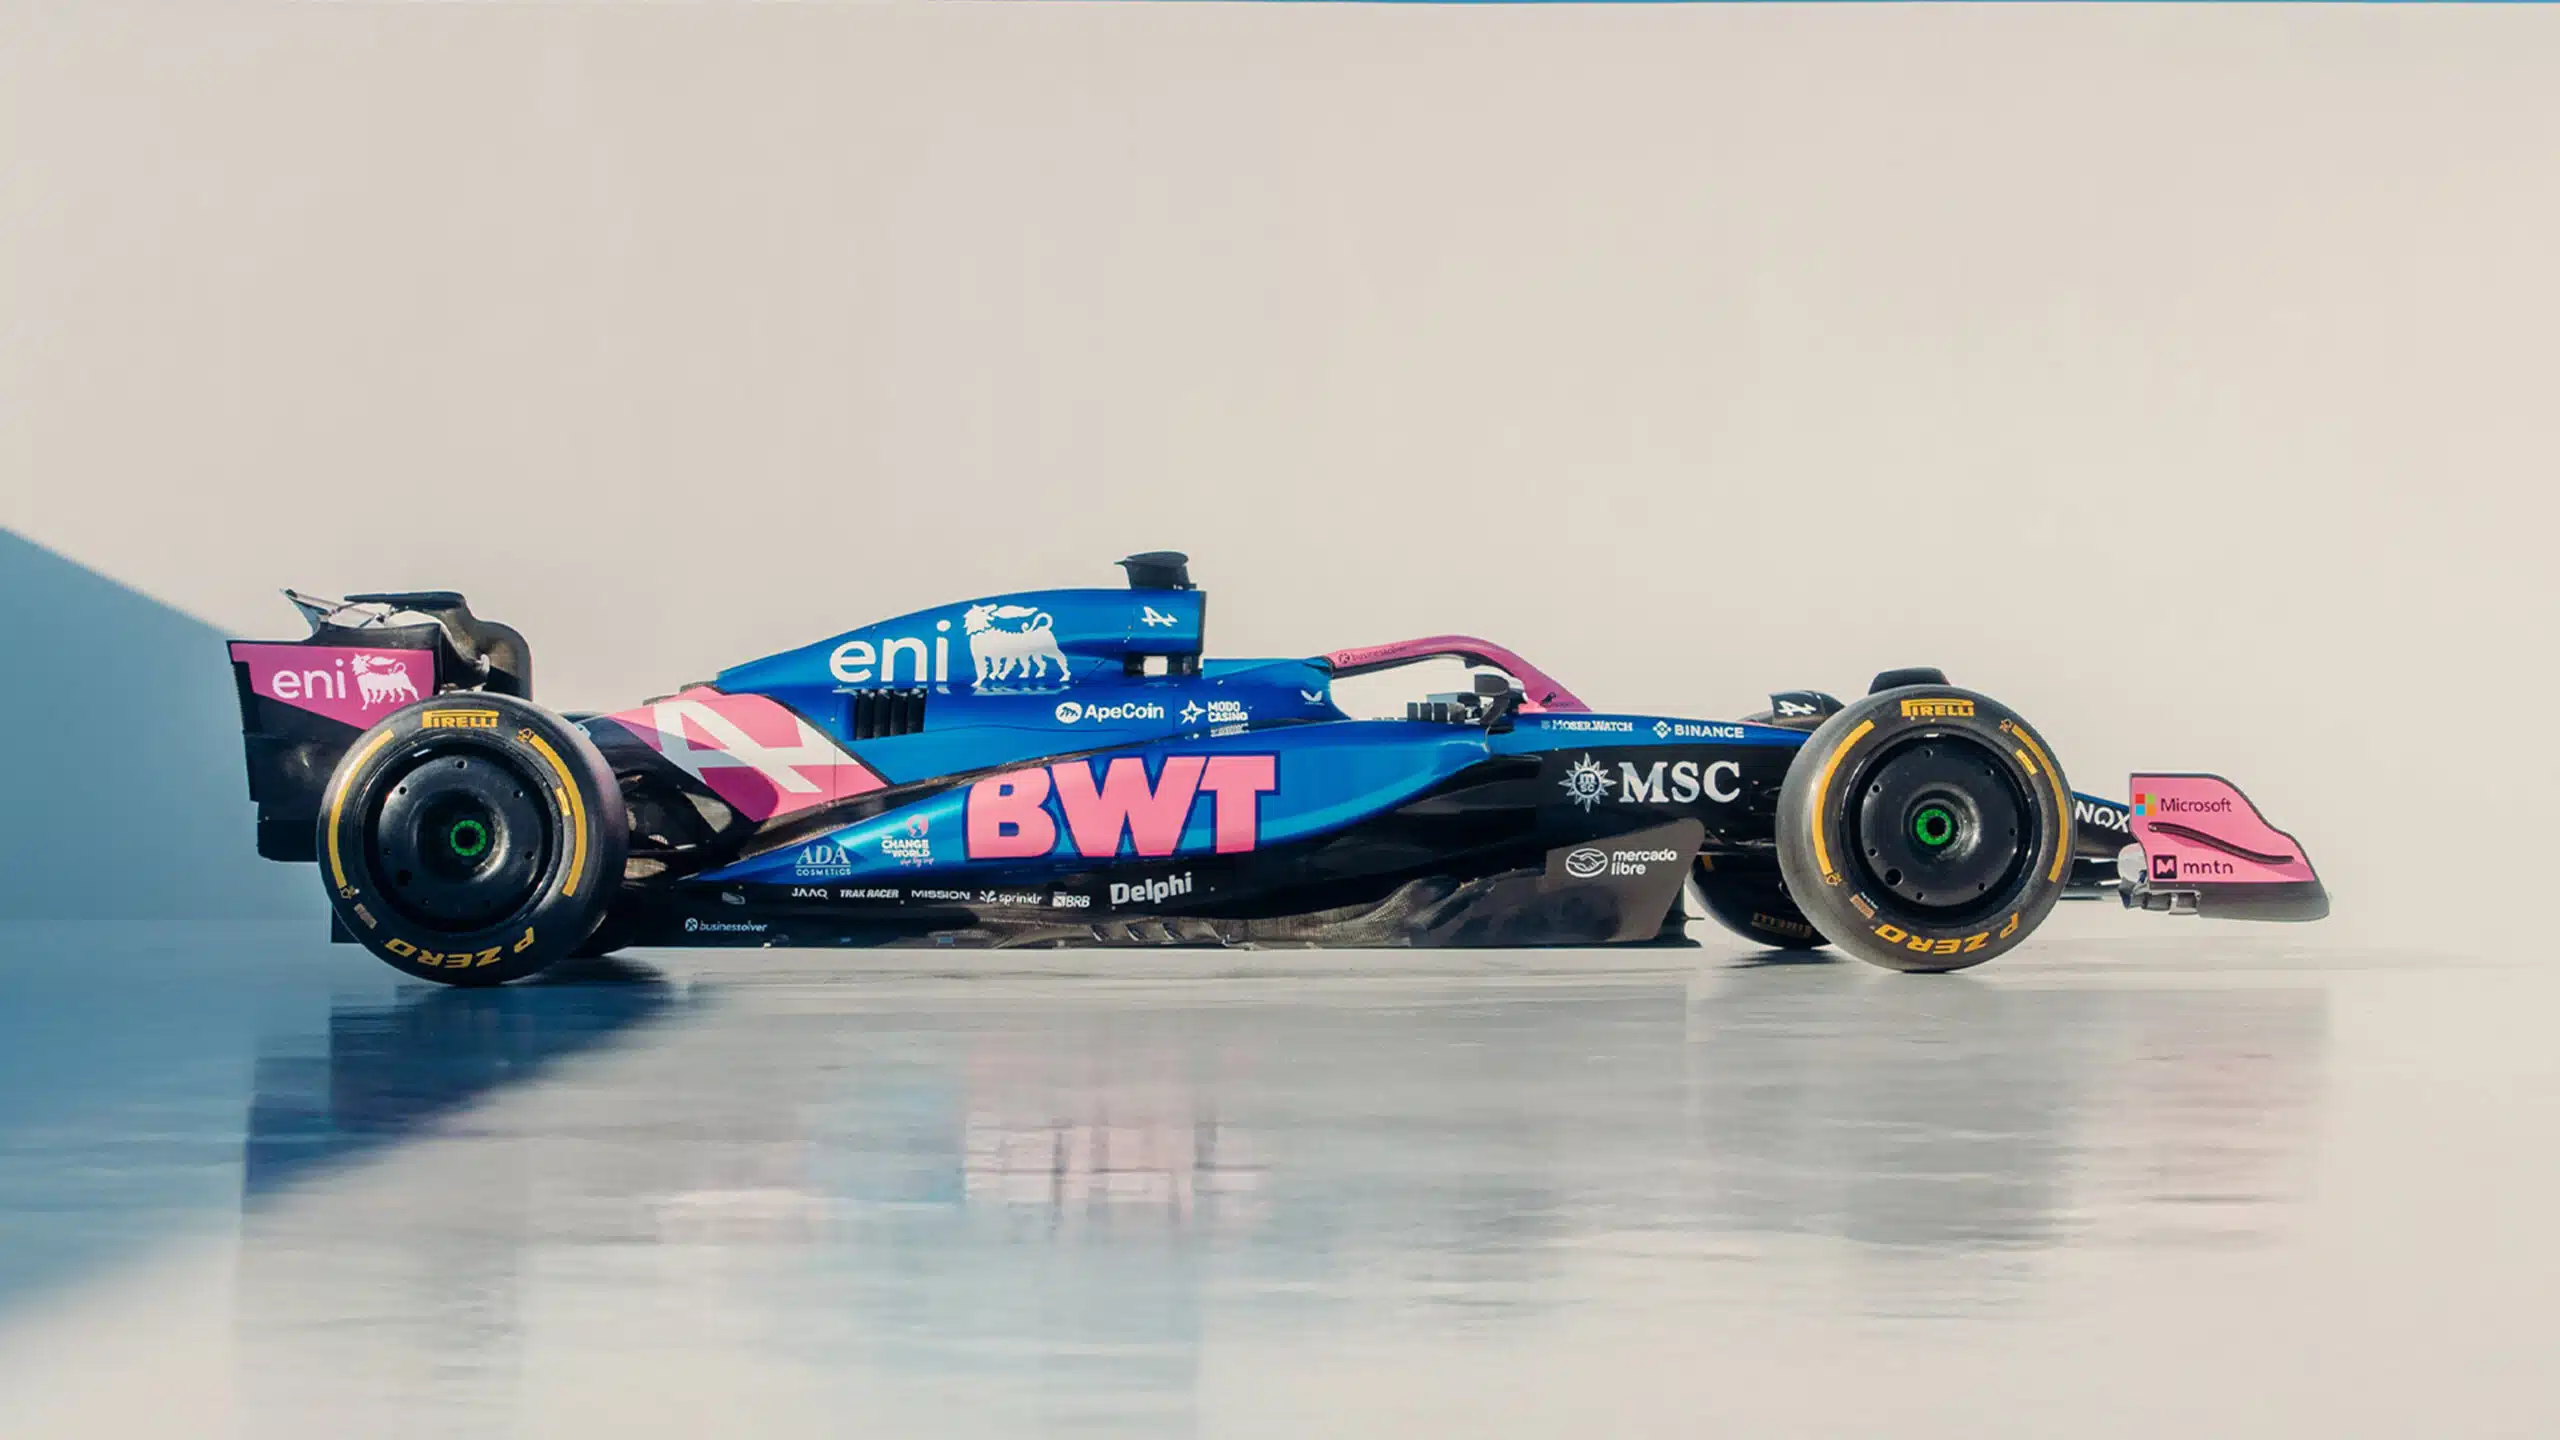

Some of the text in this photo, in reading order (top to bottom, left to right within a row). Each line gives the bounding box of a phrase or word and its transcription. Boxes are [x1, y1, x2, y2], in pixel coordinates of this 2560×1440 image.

[830, 620, 950, 683] eni
[272, 659, 346, 699] eni
[1084, 702, 1164, 723] ApeCoin
[1208, 701, 1240, 711] MODO
[1901, 698, 1975, 717] PIRELLI
[422, 709, 499, 728] PIRELLI
[1208, 711, 1248, 723] CASINO
[1674, 724, 1745, 739] BINANCE
[1618, 760, 1741, 803] MSC
[967, 754, 1277, 861] BWT
[2160, 797, 2232, 813] Microsoft
[881, 839, 929, 849] CHANGE
[797, 845, 850, 865] ADA
[892, 849, 930, 858] WORLD
[1612, 848, 1677, 862] mercado
[796, 868, 851, 877] COSMETICS
[1611, 862, 1647, 876] libre
[2183, 860, 2233, 874] mntn
[792, 888, 828, 899] JAAQ
[866, 889, 900, 898] RACER
[911, 890, 971, 900] MISSION
[1110, 871, 1192, 905] Delphi
[999, 892, 1042, 906] sprinklr
[1874, 912, 2019, 955] P ZERO
[384, 926, 535, 968] P ZERO
